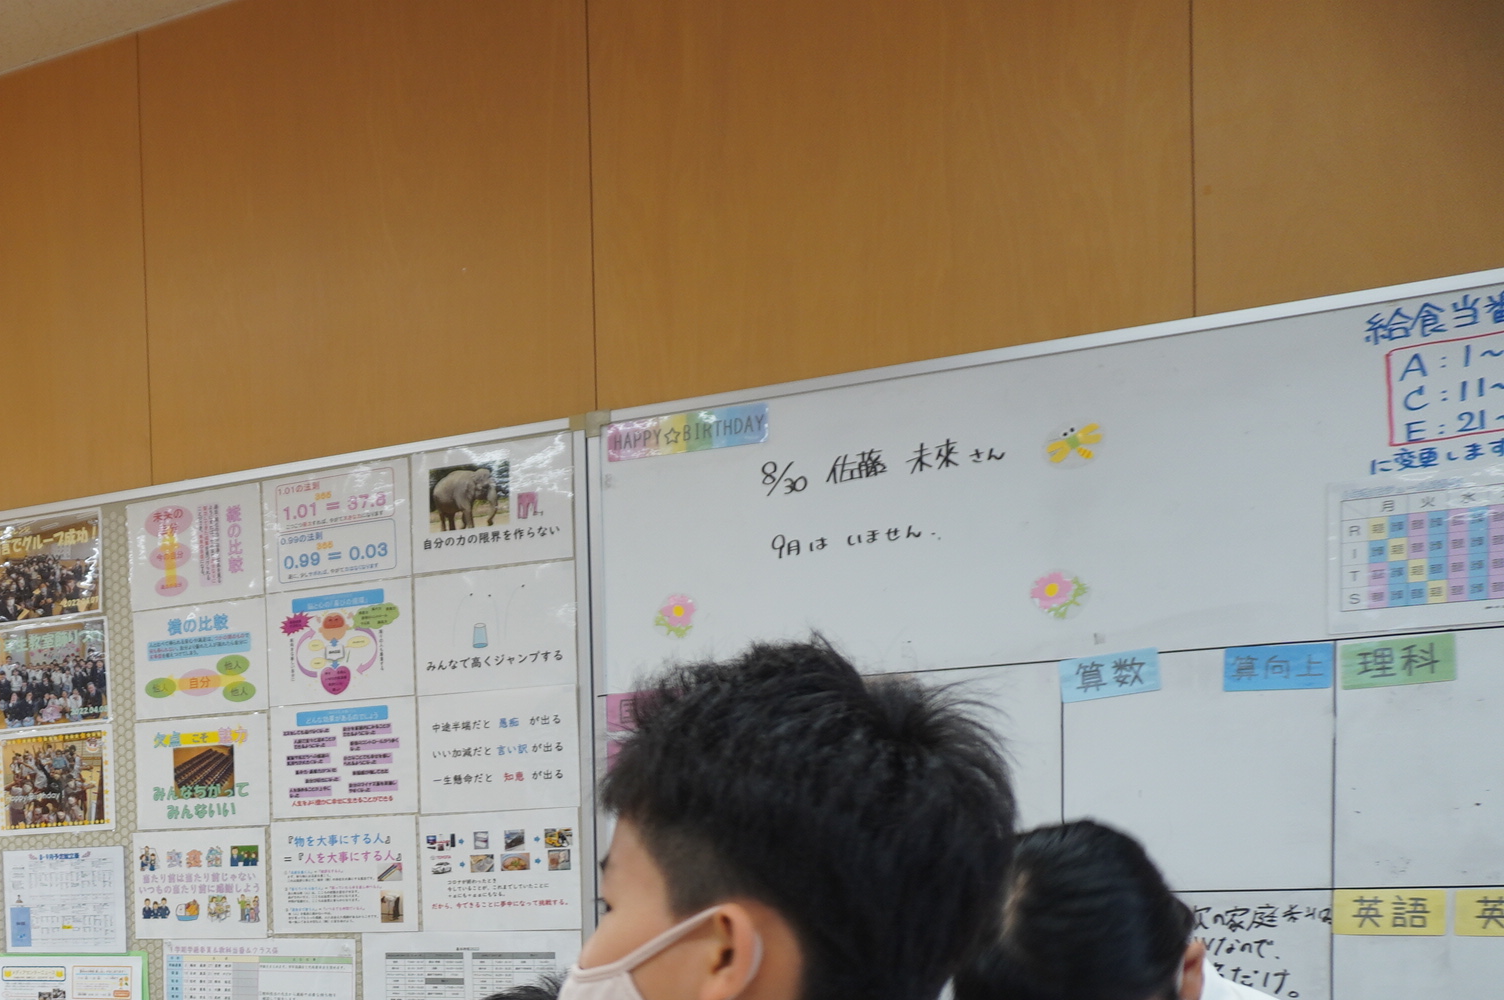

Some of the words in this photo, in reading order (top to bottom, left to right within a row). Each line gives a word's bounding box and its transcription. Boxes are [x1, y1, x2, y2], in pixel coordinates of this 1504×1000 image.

[613, 428, 662, 450] HAPPY
[682, 413, 765, 442] BIRTHDAY
[760, 460, 808, 497] 8/30
[969, 447, 1006, 463] さん
[278, 481, 320, 495] 1.01の法則
[314, 490, 332, 500] 365
[283, 502, 317, 520] 1.01
[347, 491, 386, 510] 37.8
[1381, 500, 1394, 512] 月
[1420, 496, 1436, 508] 火
[226, 504, 244, 574] 縦の比較
[280, 531, 323, 545] 0.99の法則
[423, 525, 560, 550] 自分の力の限界を作らない
[1348, 525, 1361, 537] R
[316, 541, 333, 550] 365
[283, 551, 320, 570] 0.99
[349, 542, 388, 560] 0.03
[1349, 593, 1360, 604] S
[167, 613, 228, 636] 横の比較
[426, 650, 563, 671] みんなで高くジャンプする
[1231, 654, 1324, 680] 算向上
[1357, 643, 1440, 678] 理科
[189, 676, 210, 689] 自分
[1075, 656, 1146, 692] 算数
[432, 719, 490, 733] 中途半端だと
[530, 714, 561, 725] が出る
[153, 731, 182, 748] 欠点
[192, 733, 208, 743] こそ
[432, 747, 491, 758] いい加減だと
[496, 744, 528, 756] 言い訳
[532, 742, 563, 753] が出る
[433, 774, 492, 785] 一生懸命だと
[504, 771, 524, 782] 知恵
[532, 769, 563, 780] が出る
[153, 782, 249, 801] みんなちがって
[167, 802, 236, 819] みんないい
[143, 872, 256, 884] 当たり前は当たり前じゃない
[139, 883, 260, 895] いつもの当たり前に感謝しよう
[1351, 896, 1431, 929] 英語
